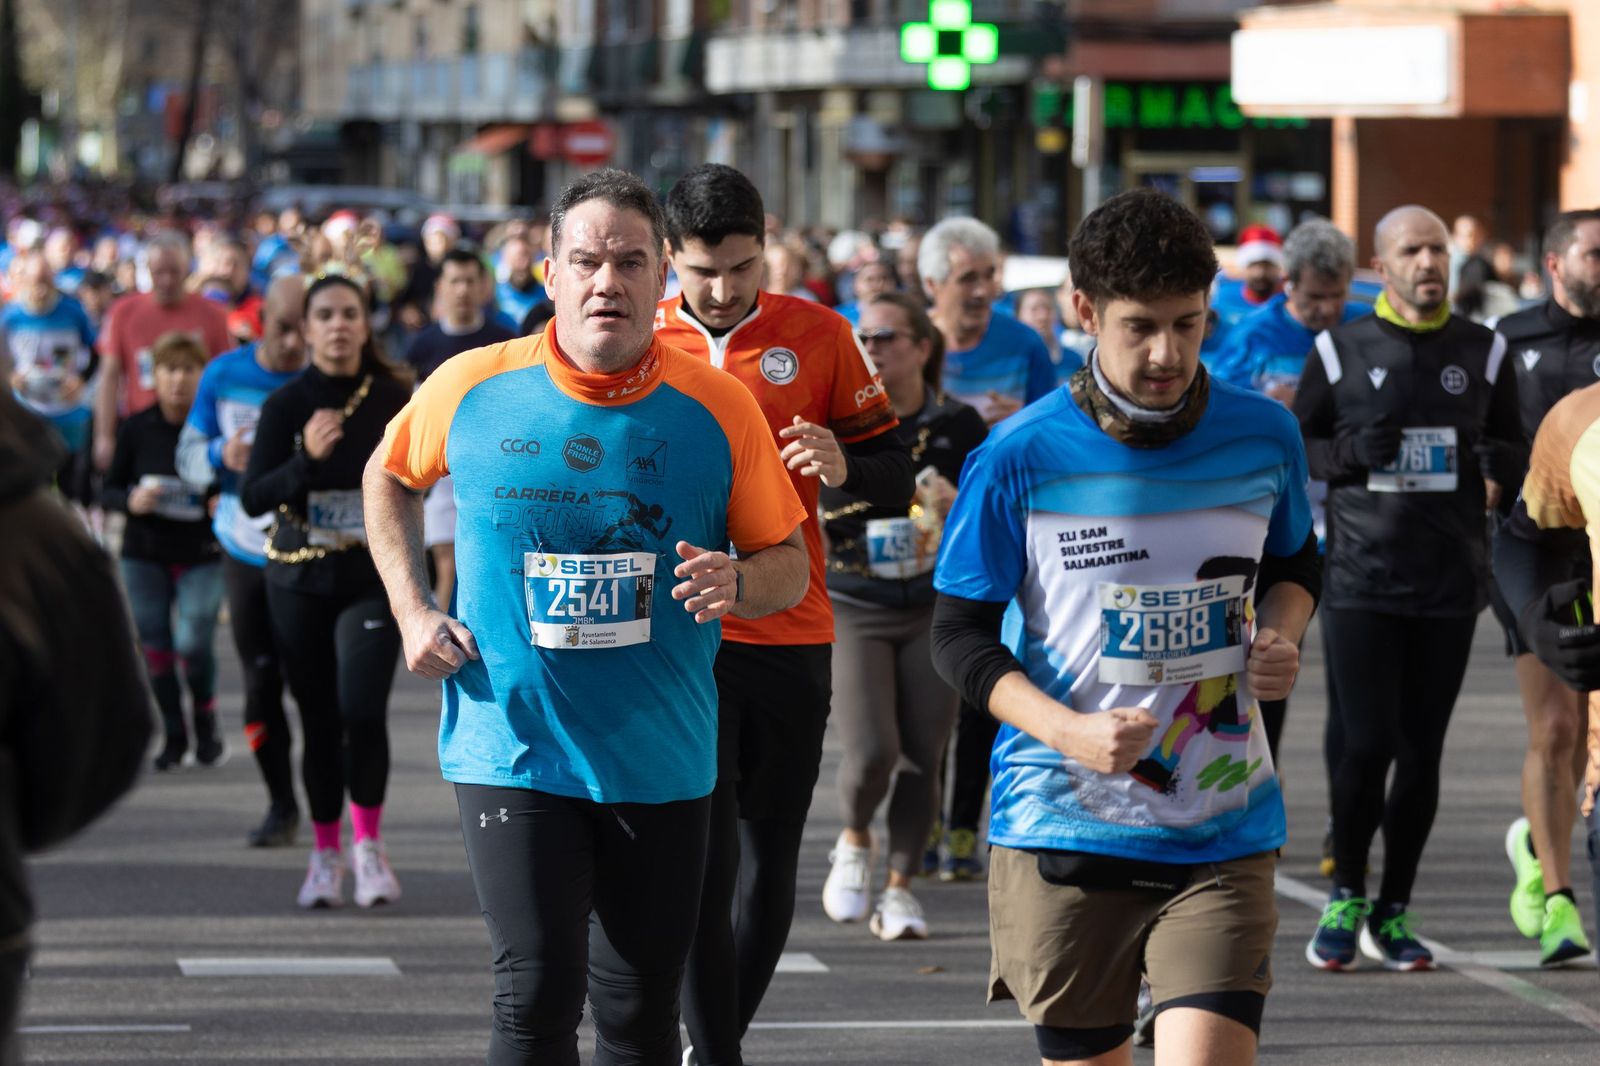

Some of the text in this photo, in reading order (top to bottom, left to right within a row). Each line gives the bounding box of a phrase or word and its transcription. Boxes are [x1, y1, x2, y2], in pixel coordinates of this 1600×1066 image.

[567, 449, 598, 465] FRENO
[569, 441, 600, 457] PONLE
[627, 456, 658, 472] AXA
[494, 486, 591, 505] CARRERA
[1058, 526, 1108, 543] XLI SAN
[1060, 538, 1125, 557] SILVESTRE
[561, 558, 642, 575] SETEL
[1063, 548, 1150, 571] SALMANTINA
[547, 579, 619, 617] 2541
[1140, 583, 1230, 608] SETEL
[581, 631, 617, 640] Ayuntamiento
[1118, 605, 1211, 652] 2688
[589, 638, 617, 646] Salamanca
